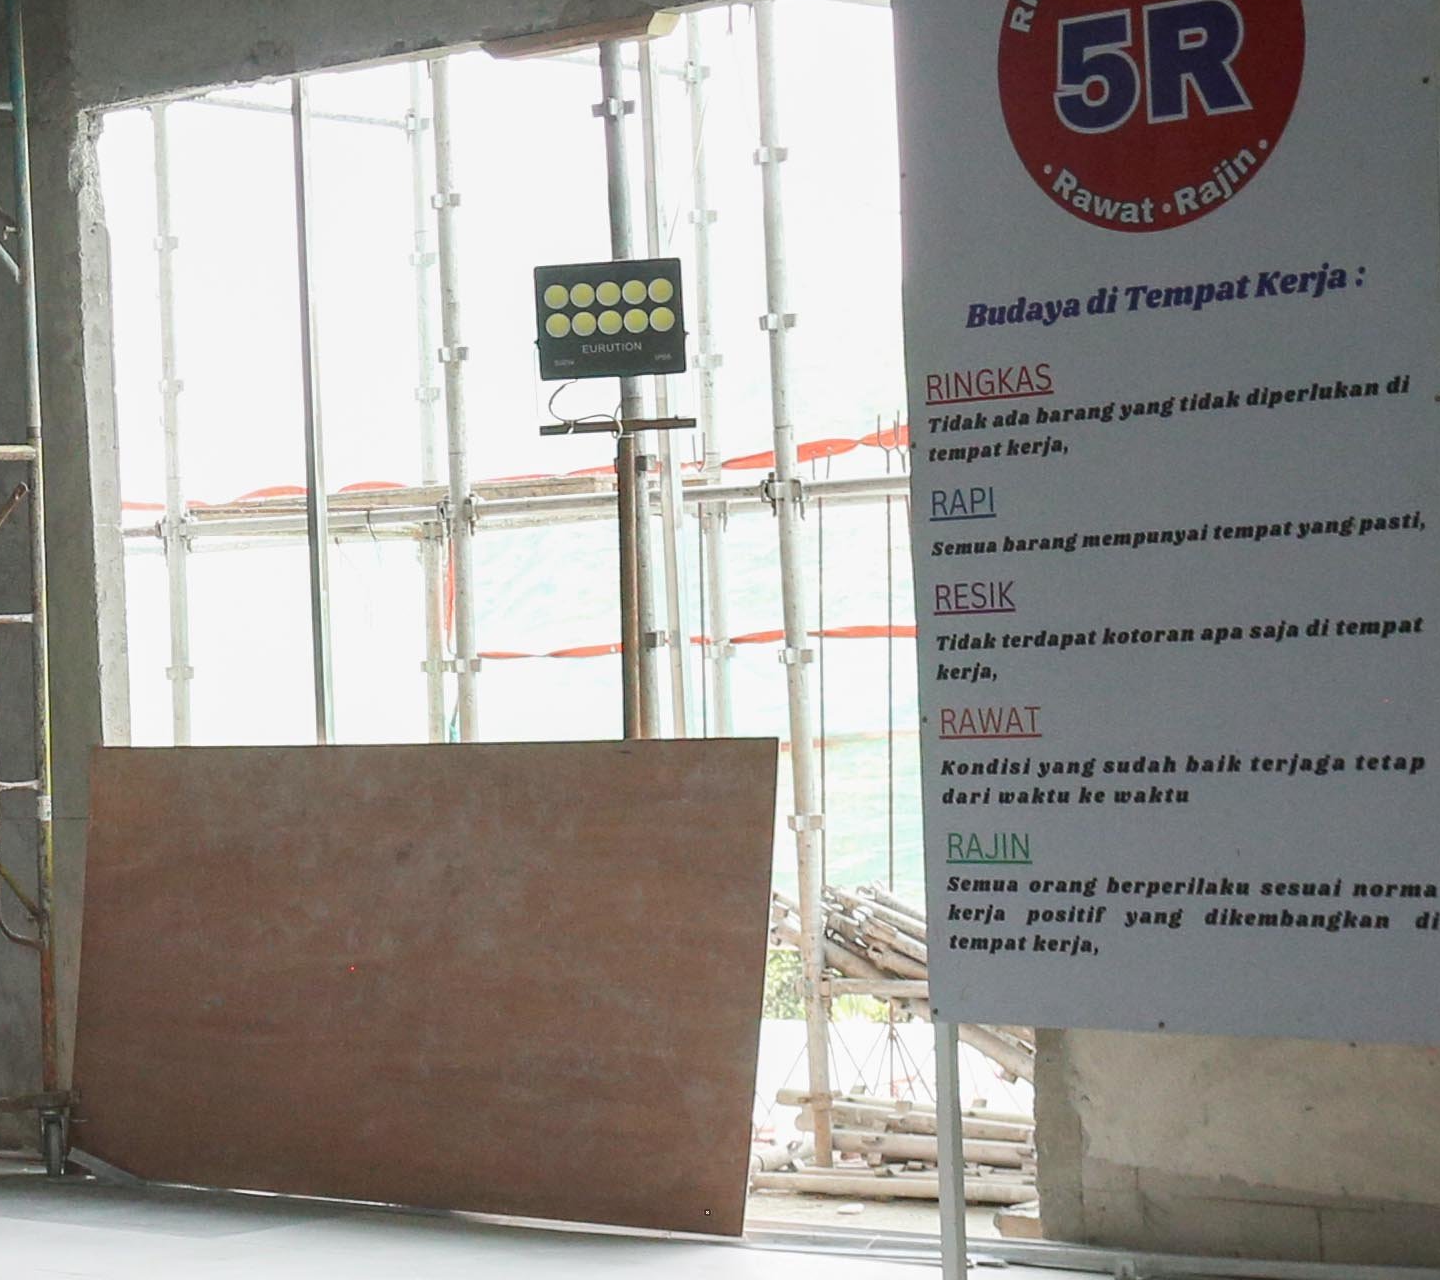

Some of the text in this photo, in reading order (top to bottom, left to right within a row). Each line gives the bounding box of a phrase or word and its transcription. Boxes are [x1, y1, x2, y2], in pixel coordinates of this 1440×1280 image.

[1054, 147, 1257, 224] Rawat Rajin
[966, 297, 1080, 328] Budaya
[1086, 286, 1118, 315] di
[1125, 275, 1251, 311] Tempat
[1254, 262, 1347, 298] Kerja
[582, 341, 642, 354] EURUTION
[925, 363, 1054, 399] RINGKAS
[928, 375, 1410, 433] Tidak ada barang yang tidak diperlukan di
[929, 442, 1002, 463] tempat
[931, 486, 996, 516] RAPI
[931, 541, 997, 556] Semua
[1003, 533, 1078, 553] barang
[1082, 524, 1208, 549] mempunyai
[1213, 521, 1293, 542] tempat
[1296, 516, 1356, 539] yang
[934, 580, 1016, 610] RESIK
[936, 617, 1423, 651] Tidak terdapat kotoran apa saja di tempat
[939, 707, 1041, 735] RAWAT
[941, 753, 1425, 778] Kondisi yang sudah baik terjaga tetap
[942, 786, 1189, 804] dari waktu ke waktu
[947, 832, 1032, 860] RAJIN
[947, 876, 1437, 898] Semua orang berperilaku sesuai norma
[948, 904, 1440, 932] kerja positif yang dikembangkan di
[950, 935, 1026, 954] tempat
